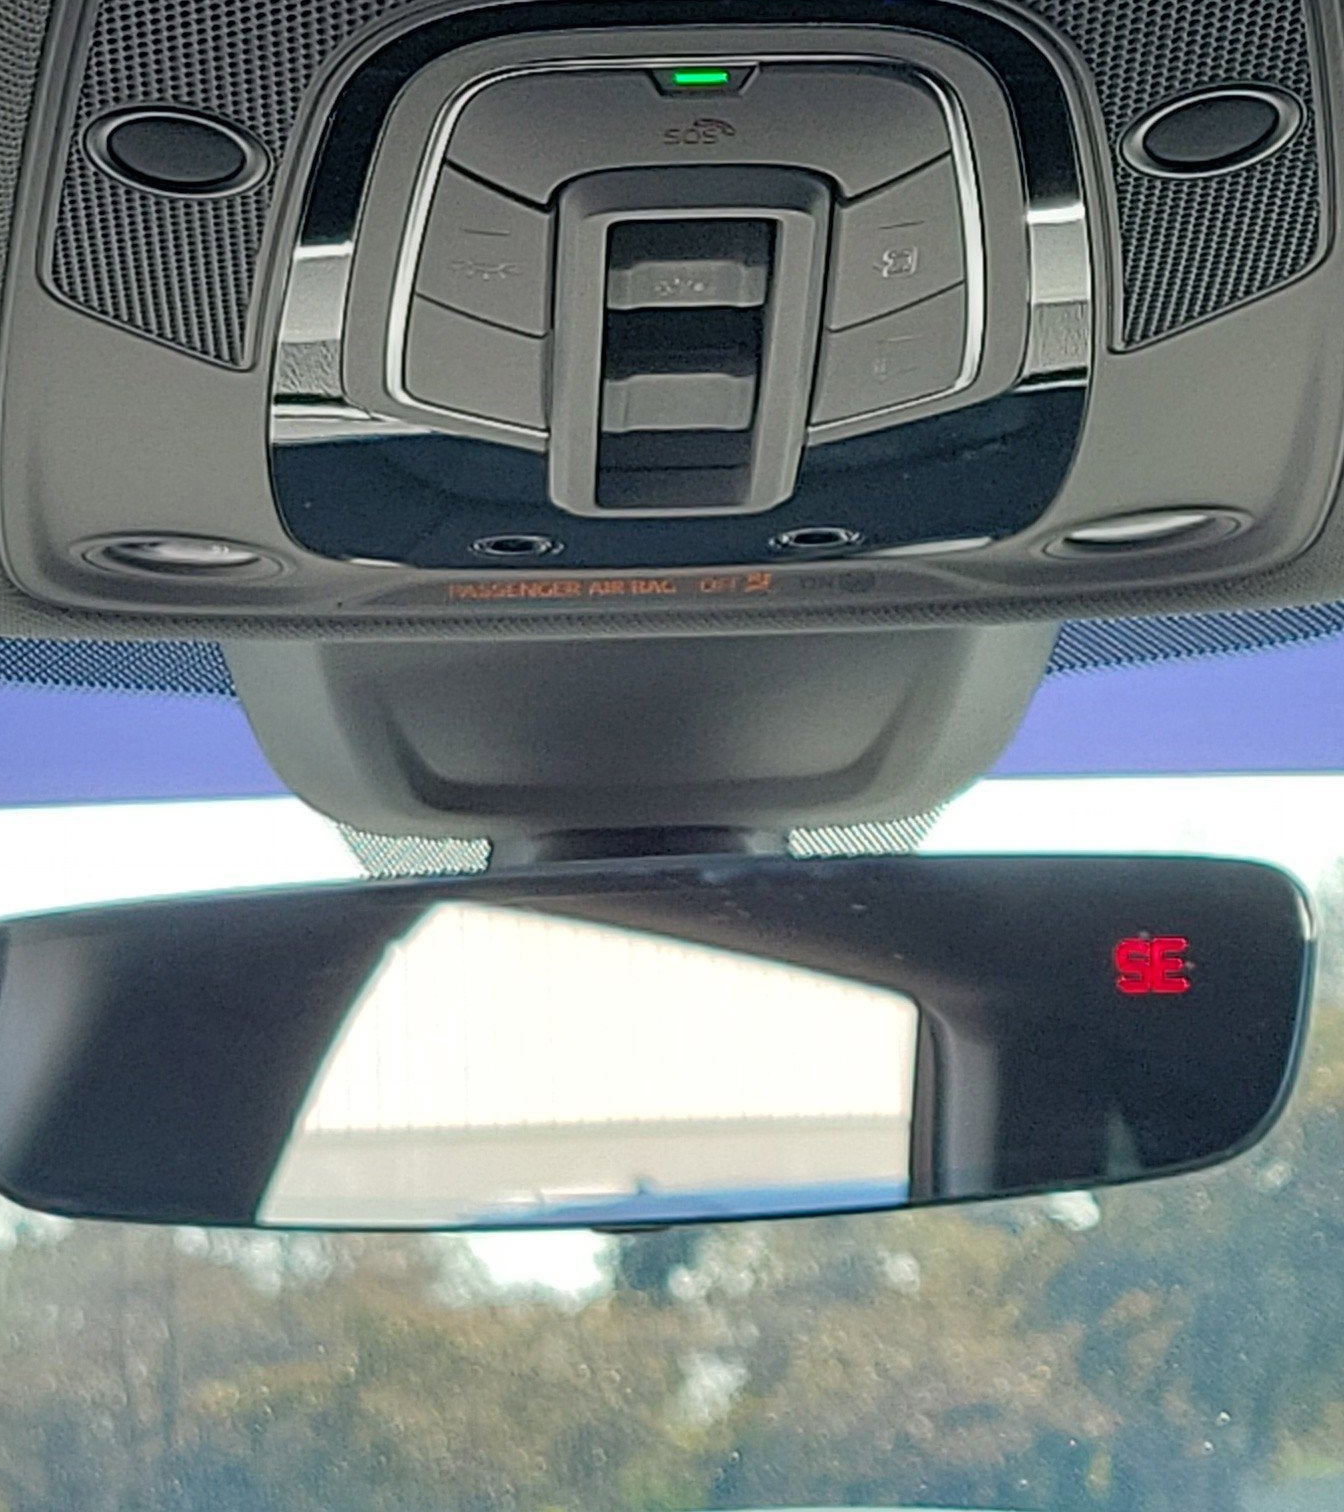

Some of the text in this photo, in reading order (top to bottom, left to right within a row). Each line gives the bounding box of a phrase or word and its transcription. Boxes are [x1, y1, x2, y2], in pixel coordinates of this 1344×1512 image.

[663, 128, 718, 145] SOS
[449, 580, 581, 599] PASSENGER
[588, 579, 626, 595] AIR
[631, 579, 676, 594] BAG
[1114, 937, 1189, 993] SE
